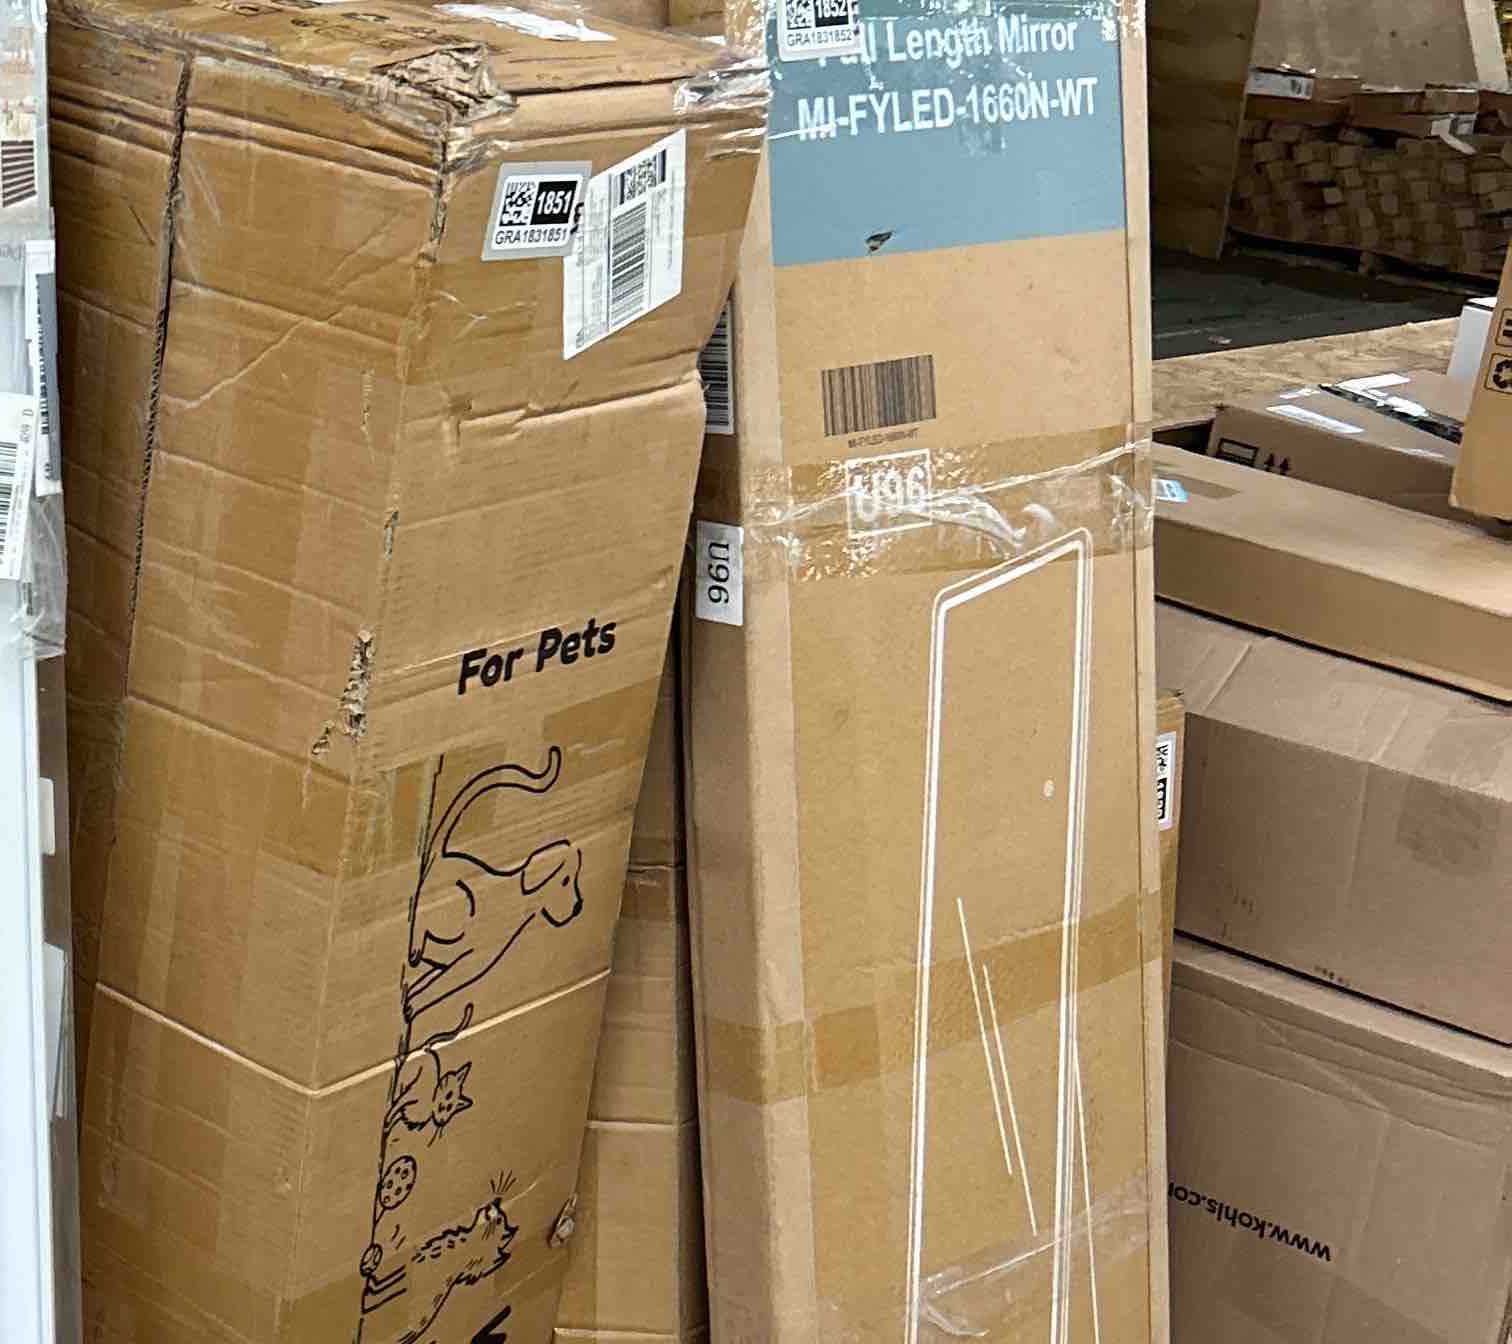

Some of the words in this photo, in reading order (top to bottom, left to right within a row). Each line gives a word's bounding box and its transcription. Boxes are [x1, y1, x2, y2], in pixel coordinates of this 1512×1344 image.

[787, 29, 852, 47] GRA1831852
[888, 18, 989, 69] Length
[998, 14, 1078, 55] Mirror
[798, 77, 1098, 141] MI-FYLED-1660N-WT
[537, 190, 572, 215] 1851
[495, 227, 567, 245] GRA1831851
[707, 542, 730, 604] U96
[457, 648, 524, 695] For
[536, 618, 617, 672] Pets
